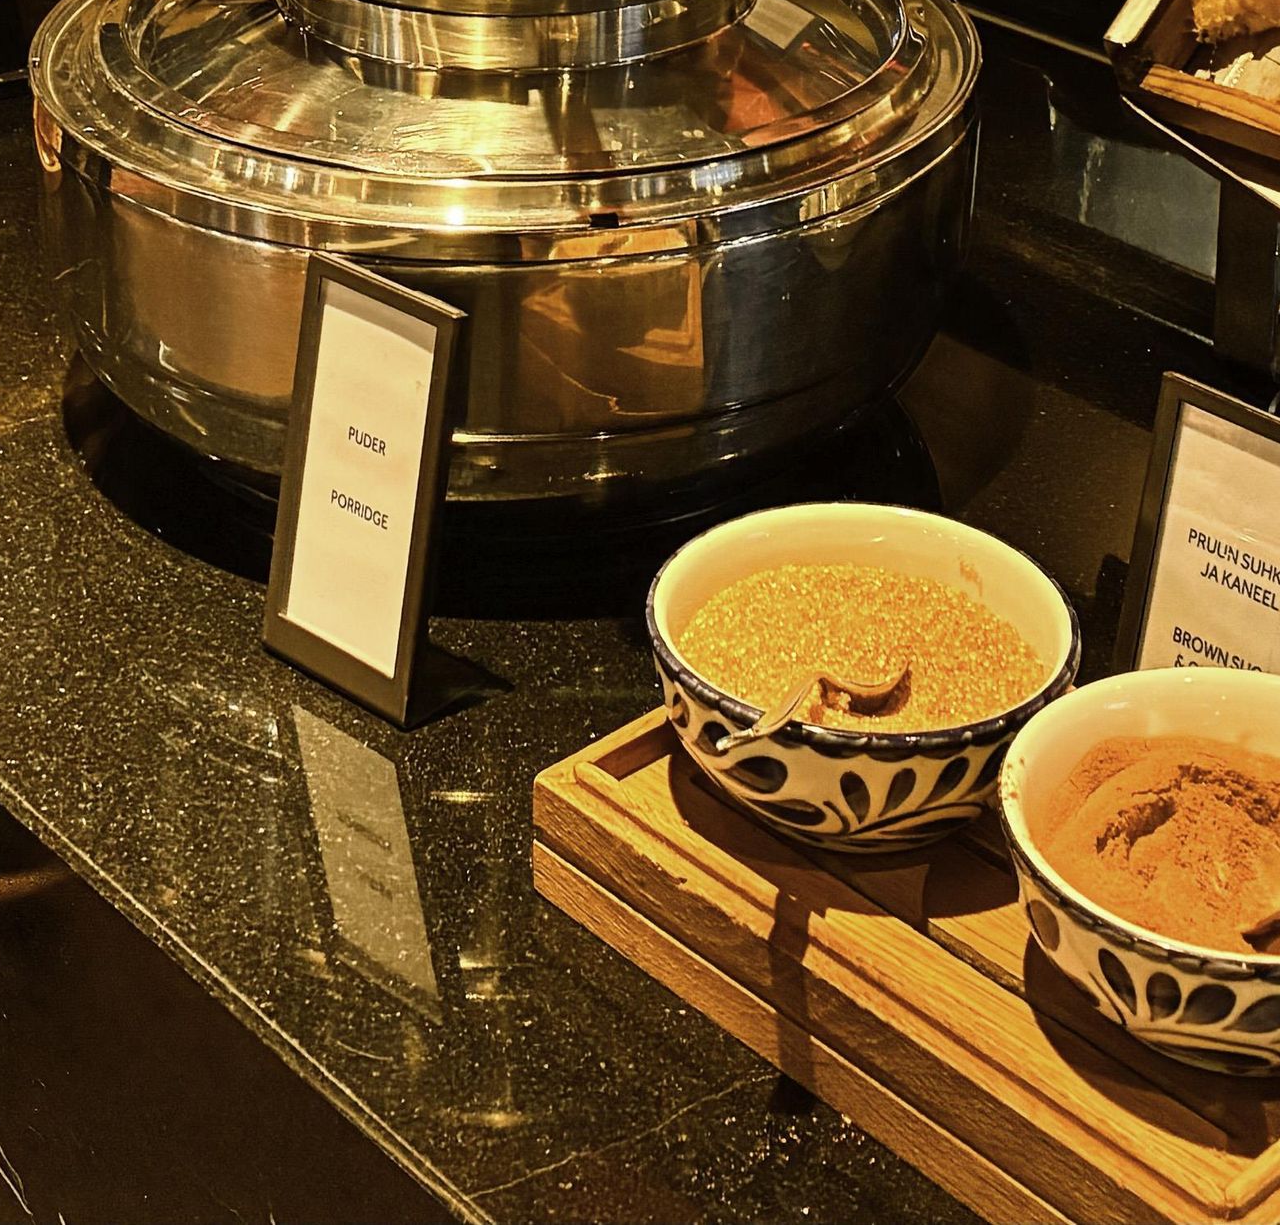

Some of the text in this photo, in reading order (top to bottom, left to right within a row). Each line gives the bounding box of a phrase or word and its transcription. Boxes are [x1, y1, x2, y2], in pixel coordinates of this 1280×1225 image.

[347, 425, 387, 457] PUDER
[330, 489, 389, 531] PORRIDGE
[1187, 528, 1239, 566] PRUUN
[1200, 562, 1280, 611] JA KANEEL
[1172, 626, 1230, 667] BROWN
